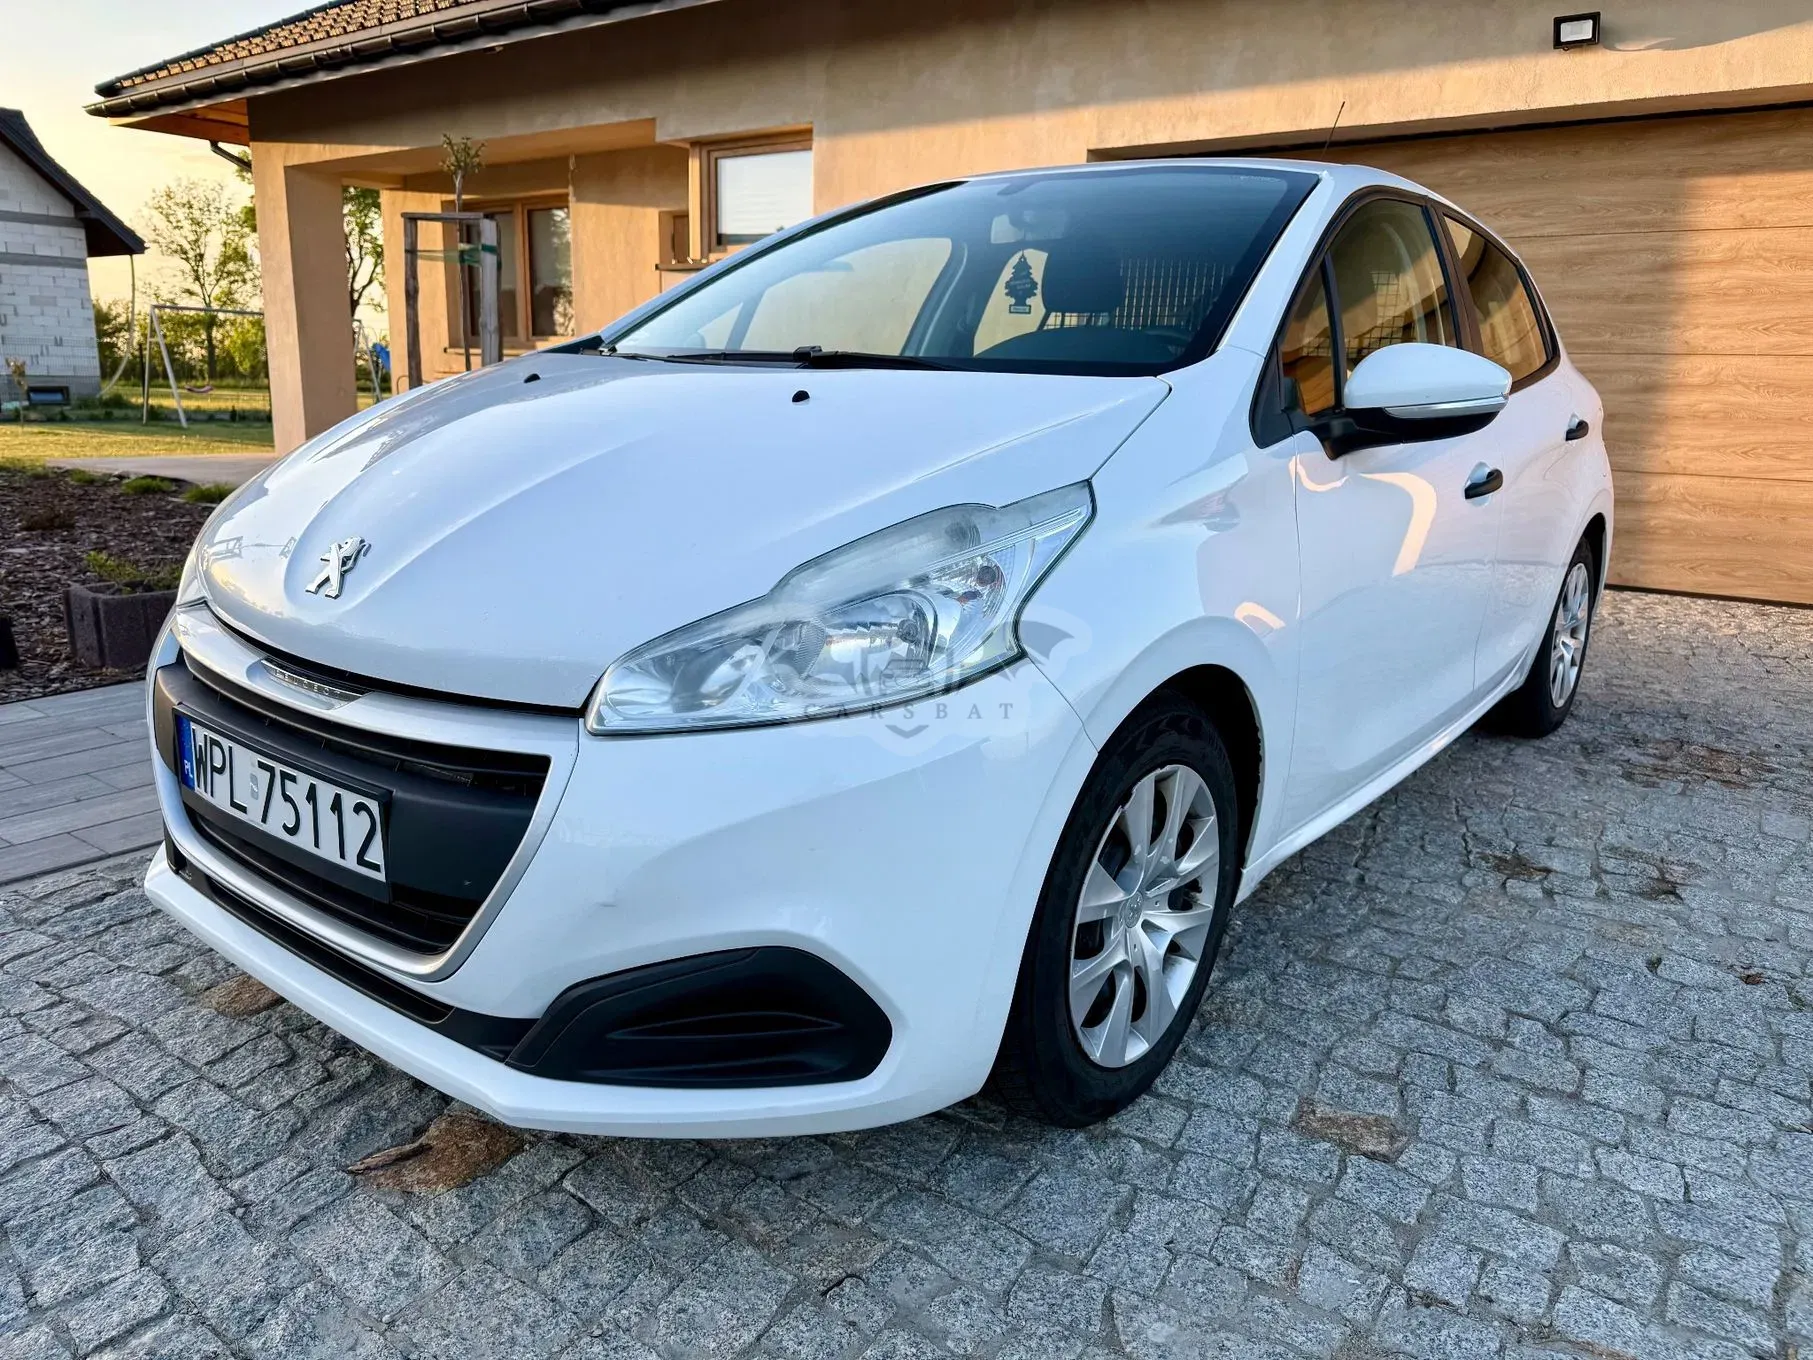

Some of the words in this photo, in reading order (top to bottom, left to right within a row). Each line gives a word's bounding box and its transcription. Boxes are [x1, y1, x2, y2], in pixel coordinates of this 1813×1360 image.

[183, 759, 194, 779] PL
[192, 726, 248, 815] WPL
[257, 758, 383, 873] 75112
